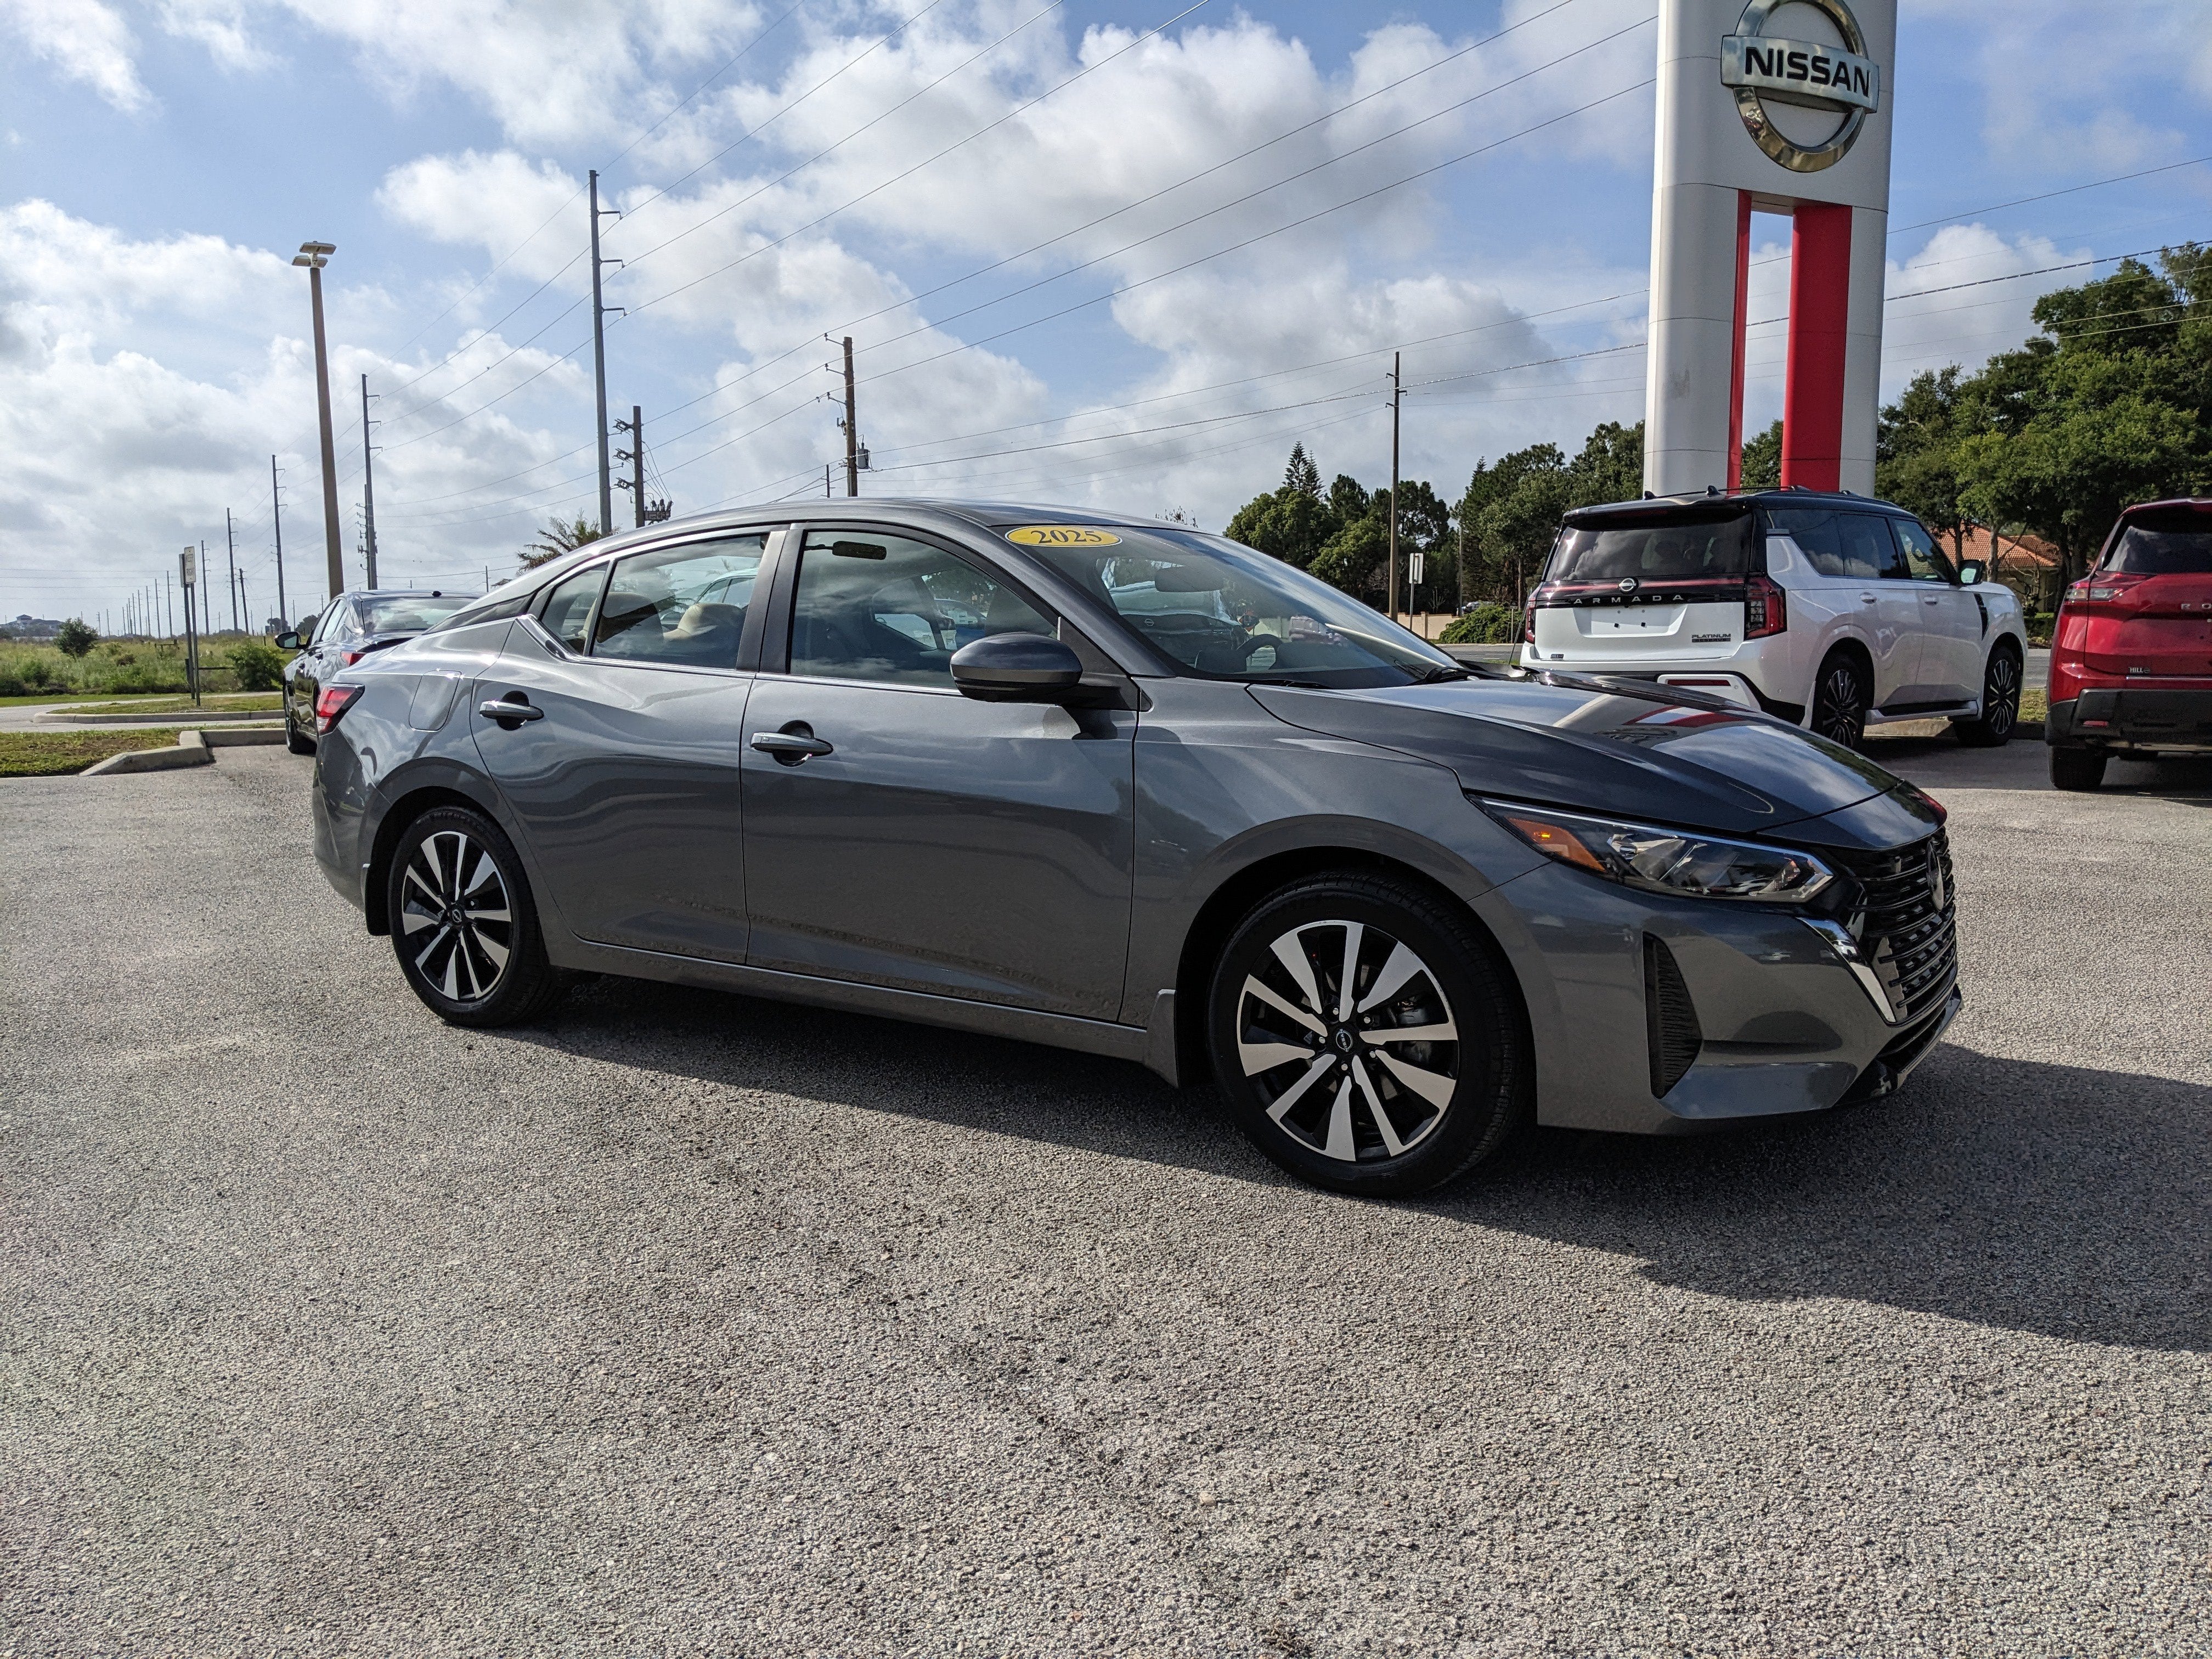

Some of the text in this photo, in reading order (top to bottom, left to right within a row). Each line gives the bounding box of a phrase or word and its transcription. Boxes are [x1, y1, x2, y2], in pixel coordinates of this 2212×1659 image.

[1745, 46, 1870, 98] NISSAN
[1030, 529, 1102, 544] 2025
[1573, 594, 1684, 604] ARMADA
[1339, 1028, 1350, 1052] NISSAN
